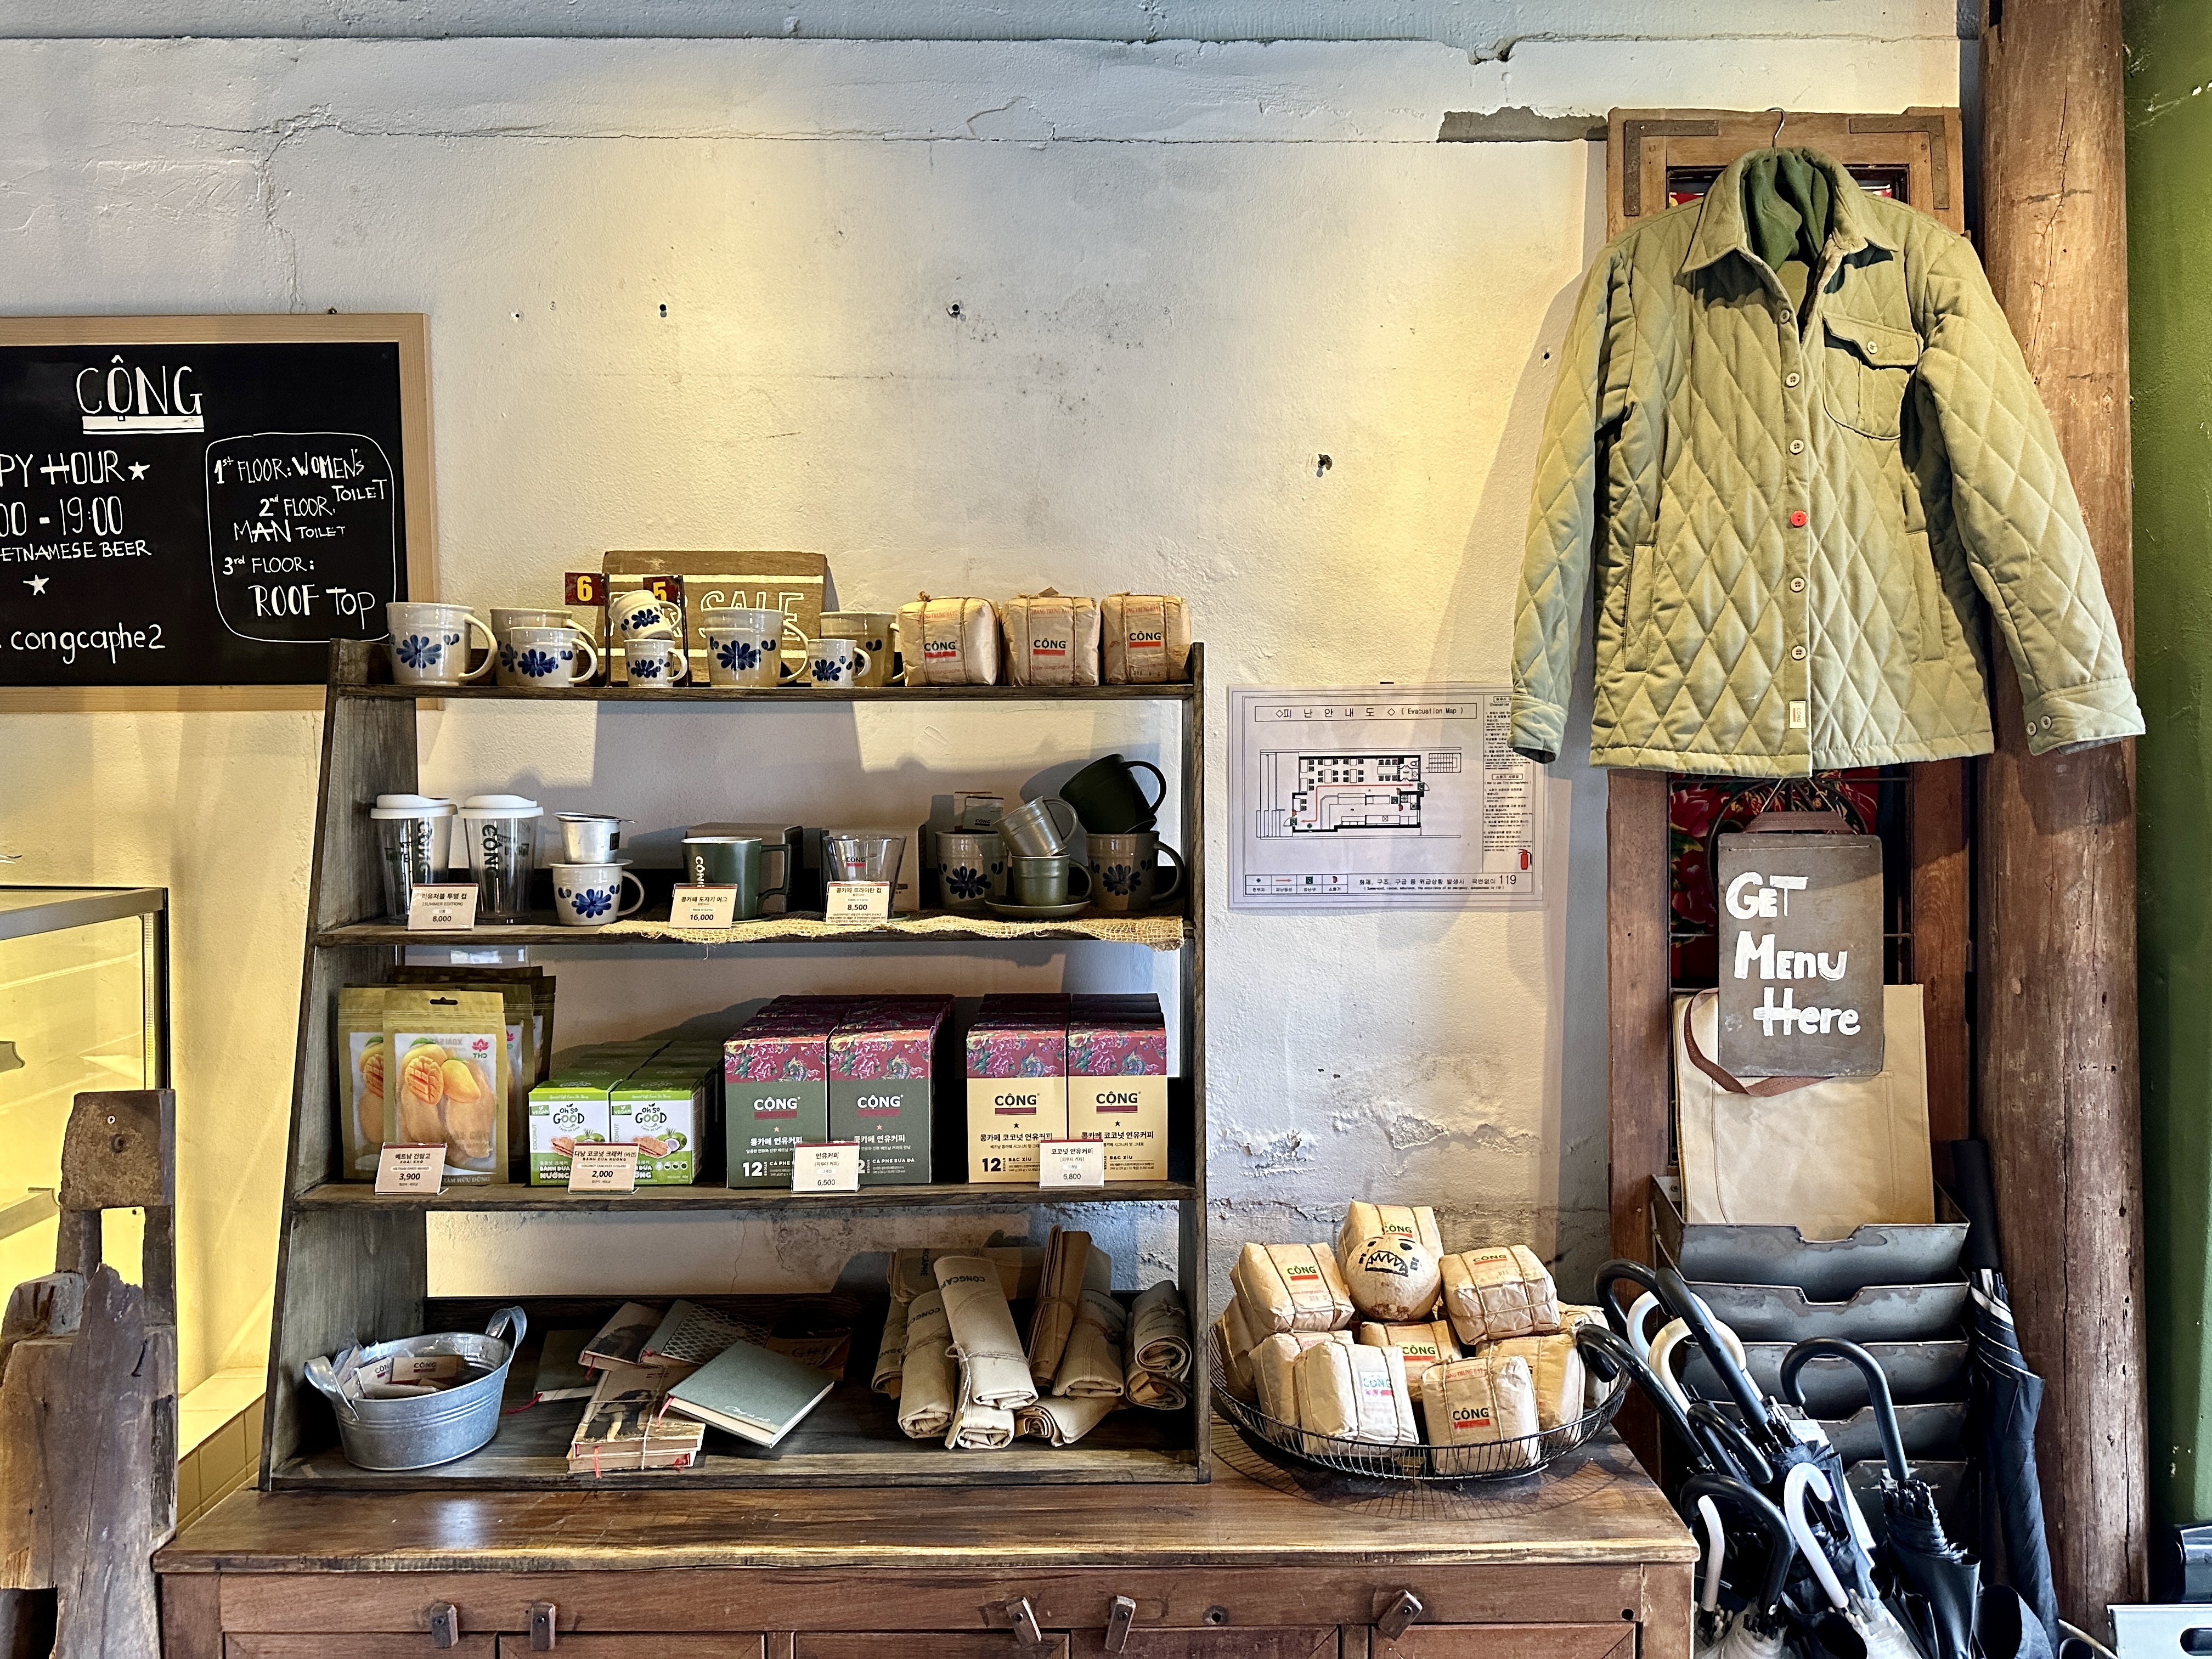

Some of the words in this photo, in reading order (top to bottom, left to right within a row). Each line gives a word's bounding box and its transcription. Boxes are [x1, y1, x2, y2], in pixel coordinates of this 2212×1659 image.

[40, 450, 125, 485] HOUR
[214, 456, 234, 484] 1st
[237, 458, 292, 483] FLOOR:
[331, 479, 387, 502] TOILET
[258, 494, 279, 517] 2nd
[60, 495, 123, 536] 19:00
[233, 519, 291, 543] MAN
[295, 526, 346, 539] TOILET
[99, 540, 152, 557] BEER
[222, 555, 245, 574] 3rd
[252, 557, 314, 573] FLOOR:
[577, 575, 592, 601] 6
[653, 581, 667, 601] 5
[248, 584, 319, 617] ROOF
[11, 622, 166, 664] congcaphe2
[1499, 874, 1516, 885] 119
[1725, 871, 1809, 919] GET
[1753, 986, 1861, 1036] Here
[553, 1113, 585, 1124] GOOD
[635, 1112, 667, 1124] GOOD
[750, 1137, 772, 1147] 콩카페
[774, 1136, 803, 1145] 연유커피
[877, 1134, 905, 1143] 연유커피
[980, 1133, 1001, 1142] 콩카페
[1002, 1133, 1023, 1142] 코코넛
[1025, 1132, 1053, 1141] 연유커피
[1081, 1131, 1102, 1139] 콩카페
[1103, 1131, 1125, 1139] 코코넛
[1126, 1131, 1154, 1139] 연유커피
[591, 1170, 613, 1178] 2,000
[742, 1161, 763, 1177] 12
[982, 1158, 1001, 1172] 12
[399, 1173, 421, 1181] 3,900
